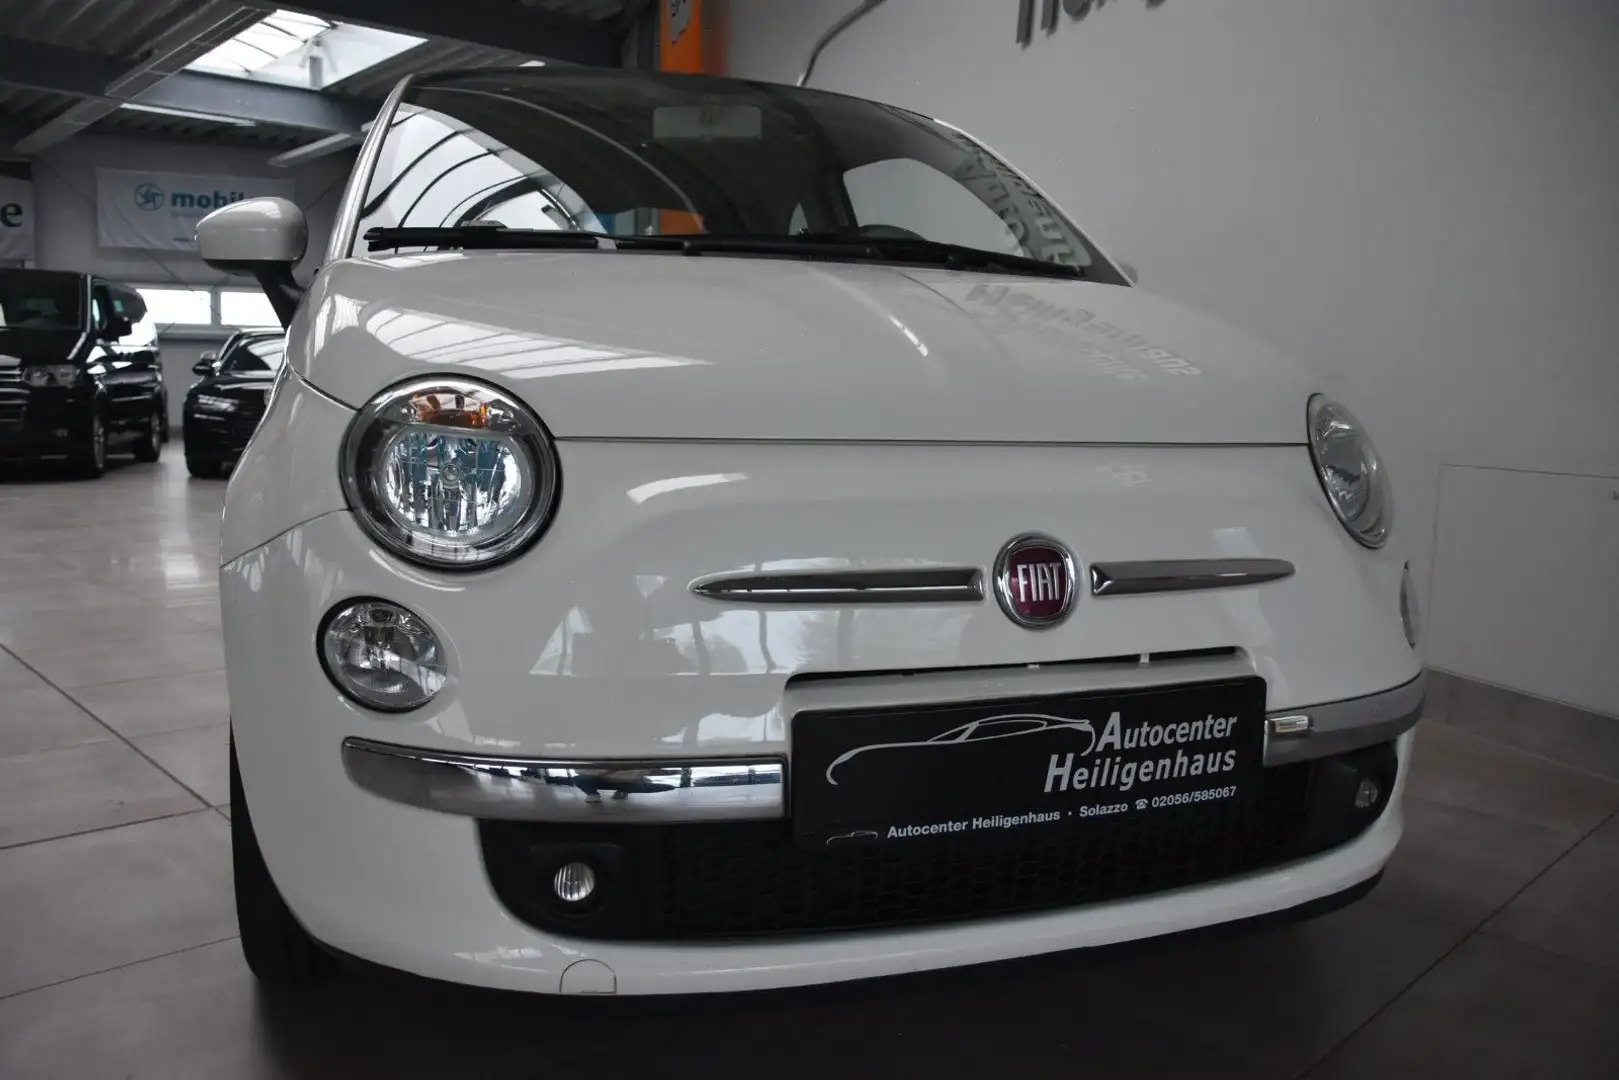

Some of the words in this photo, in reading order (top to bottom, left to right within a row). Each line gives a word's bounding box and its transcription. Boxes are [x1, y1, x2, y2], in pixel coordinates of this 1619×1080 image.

[1016, 562, 1062, 603] FIAT
[1095, 711, 1238, 752] Autocenter
[1043, 749, 1237, 793] Heiligenhaus
[886, 820, 969, 839] Autocenter
[971, 810, 1061, 830] Heiligenhaus
[1078, 802, 1129, 818] Solazzo
[1151, 785, 1237, 808] 02056/585067
